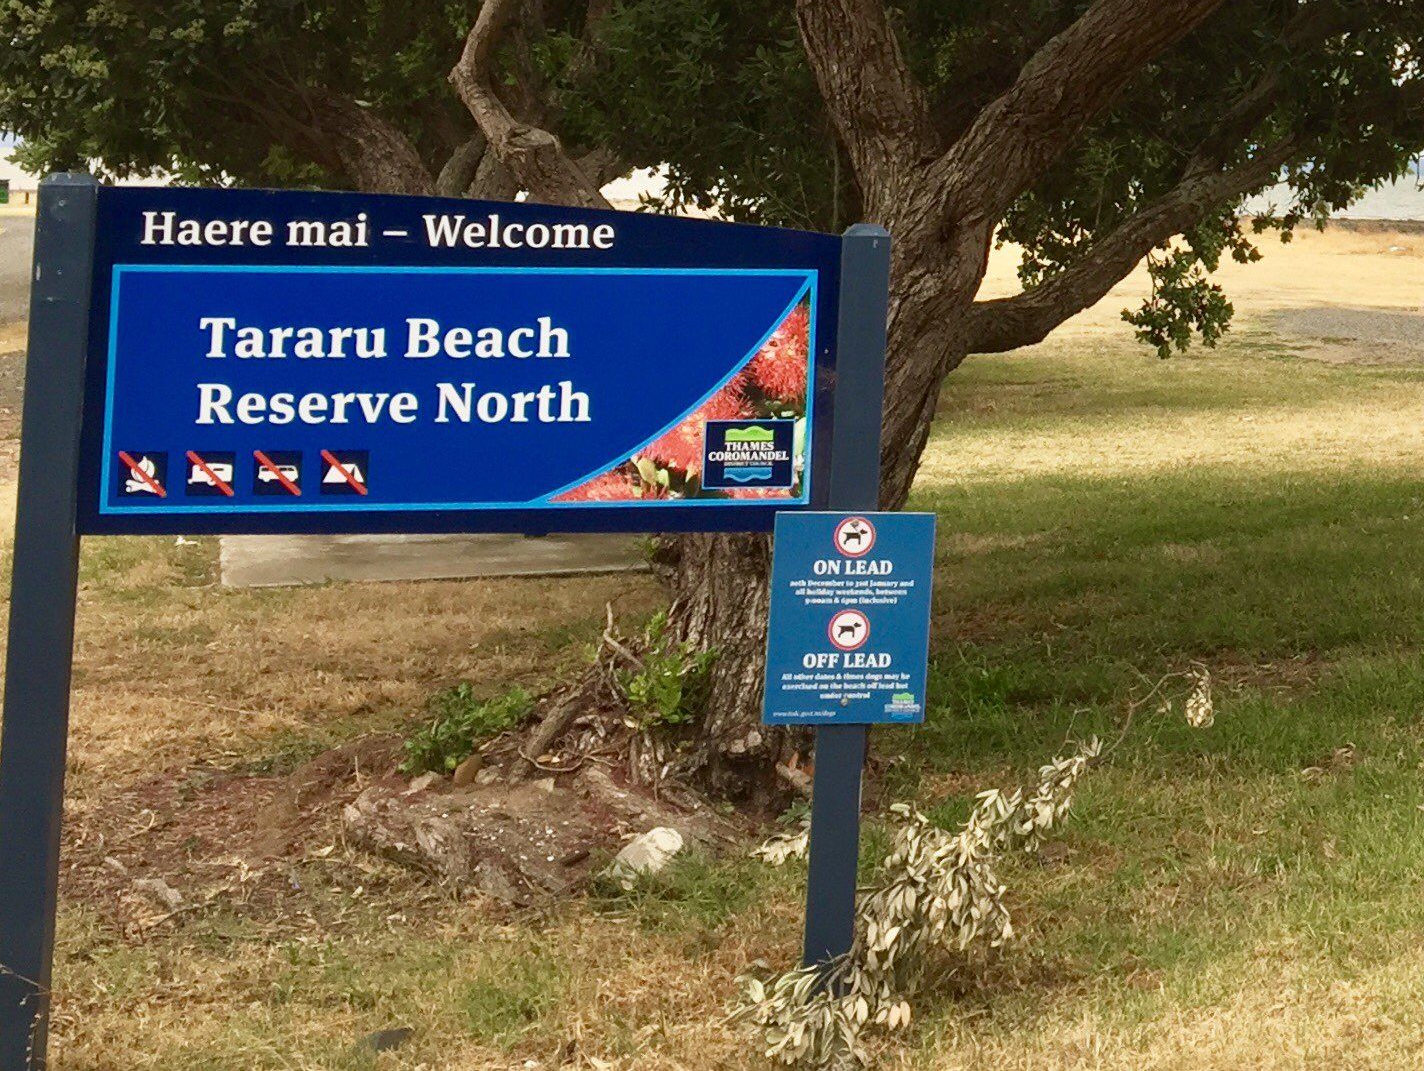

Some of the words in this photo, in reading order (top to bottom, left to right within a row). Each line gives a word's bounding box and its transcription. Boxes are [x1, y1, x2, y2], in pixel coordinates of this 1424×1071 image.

[141, 211, 273, 247] Haere
[285, 213, 368, 247] mai
[423, 214, 616, 249] Welcome
[200, 317, 387, 359] Tararu
[404, 316, 571, 359] Beach
[195, 383, 418, 425] Reserve
[434, 381, 592, 424] North
[725, 441, 774, 451] THAMES
[708, 451, 789, 462] COROMANDEL
[813, 559, 841, 575] ON
[844, 559, 893, 575] LEAD
[807, 579, 845, 587] December
[802, 652, 839, 669] OFF
[843, 652, 892, 669] LEAD
